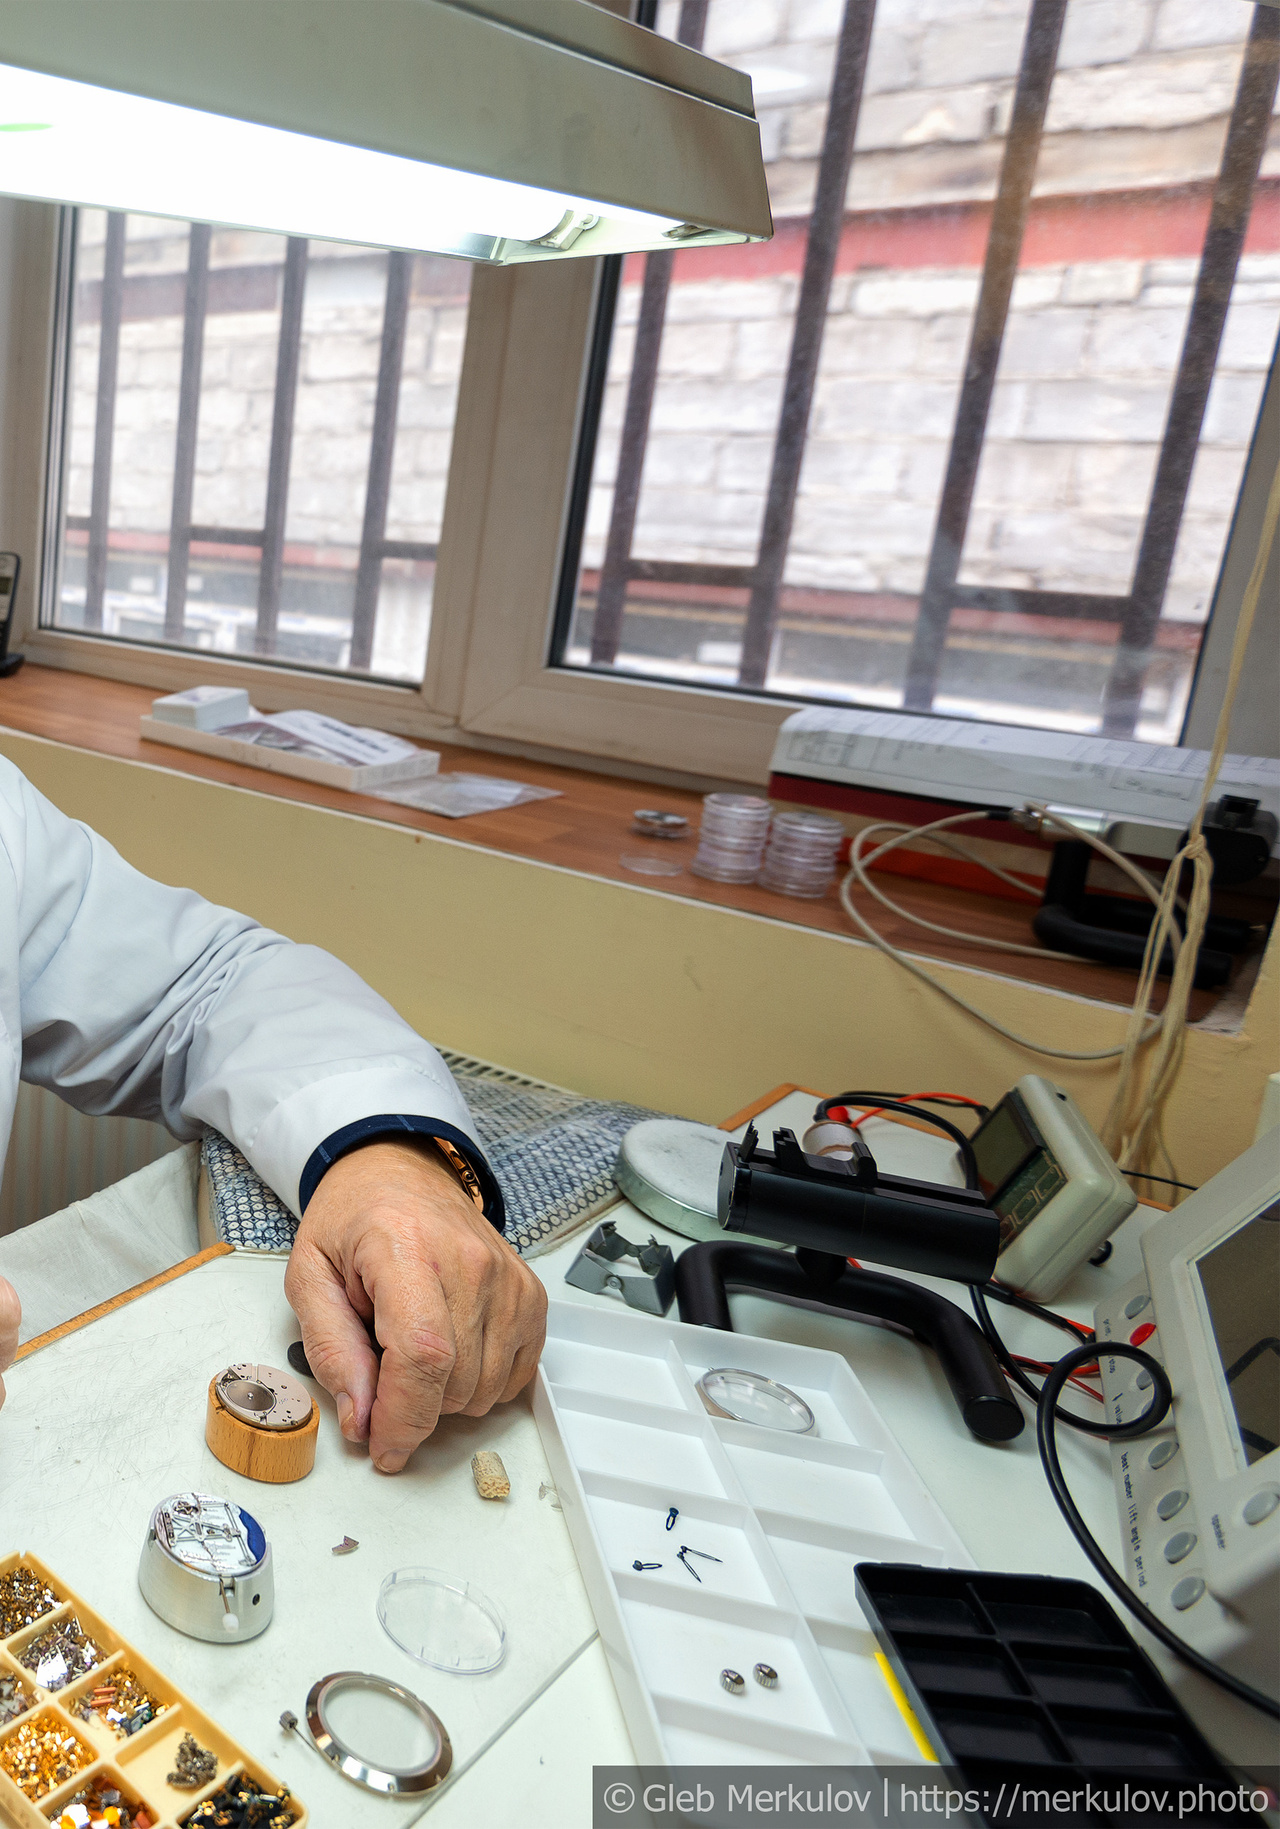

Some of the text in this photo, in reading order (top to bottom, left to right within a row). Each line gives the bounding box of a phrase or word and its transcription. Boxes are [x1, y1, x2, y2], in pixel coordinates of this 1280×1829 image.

[1121, 1452, 1133, 1499] beat number
[1128, 1503, 1141, 1551] lift angle
[1135, 1556, 1147, 1587] period
